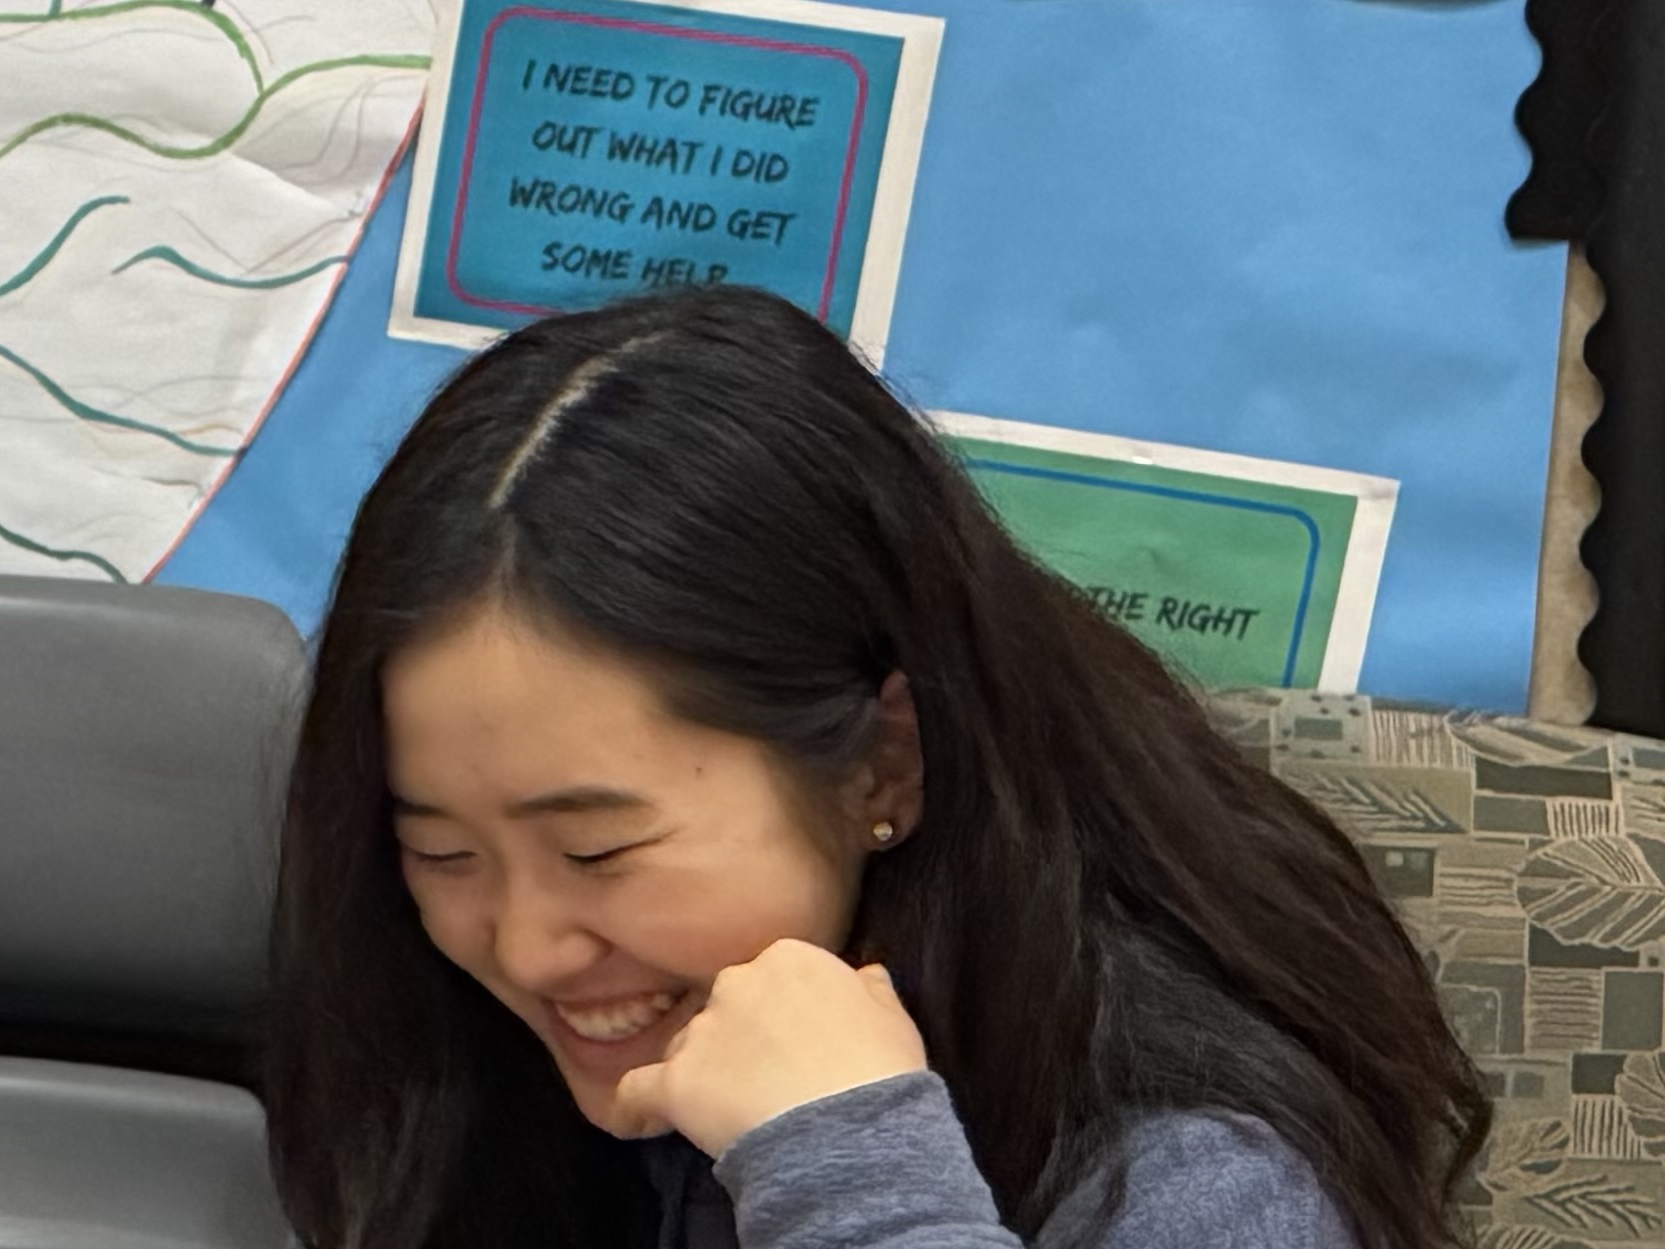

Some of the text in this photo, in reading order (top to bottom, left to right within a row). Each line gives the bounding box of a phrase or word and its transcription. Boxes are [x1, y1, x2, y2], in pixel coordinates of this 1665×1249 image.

[522, 59, 821, 131] I NEED TO FIGURE
[531, 120, 790, 183] OUT WHAT I DID
[508, 176, 797, 246] WRONG AND GET
[541, 241, 633, 281] SOME
[1155, 596, 1261, 641] RIGHT
